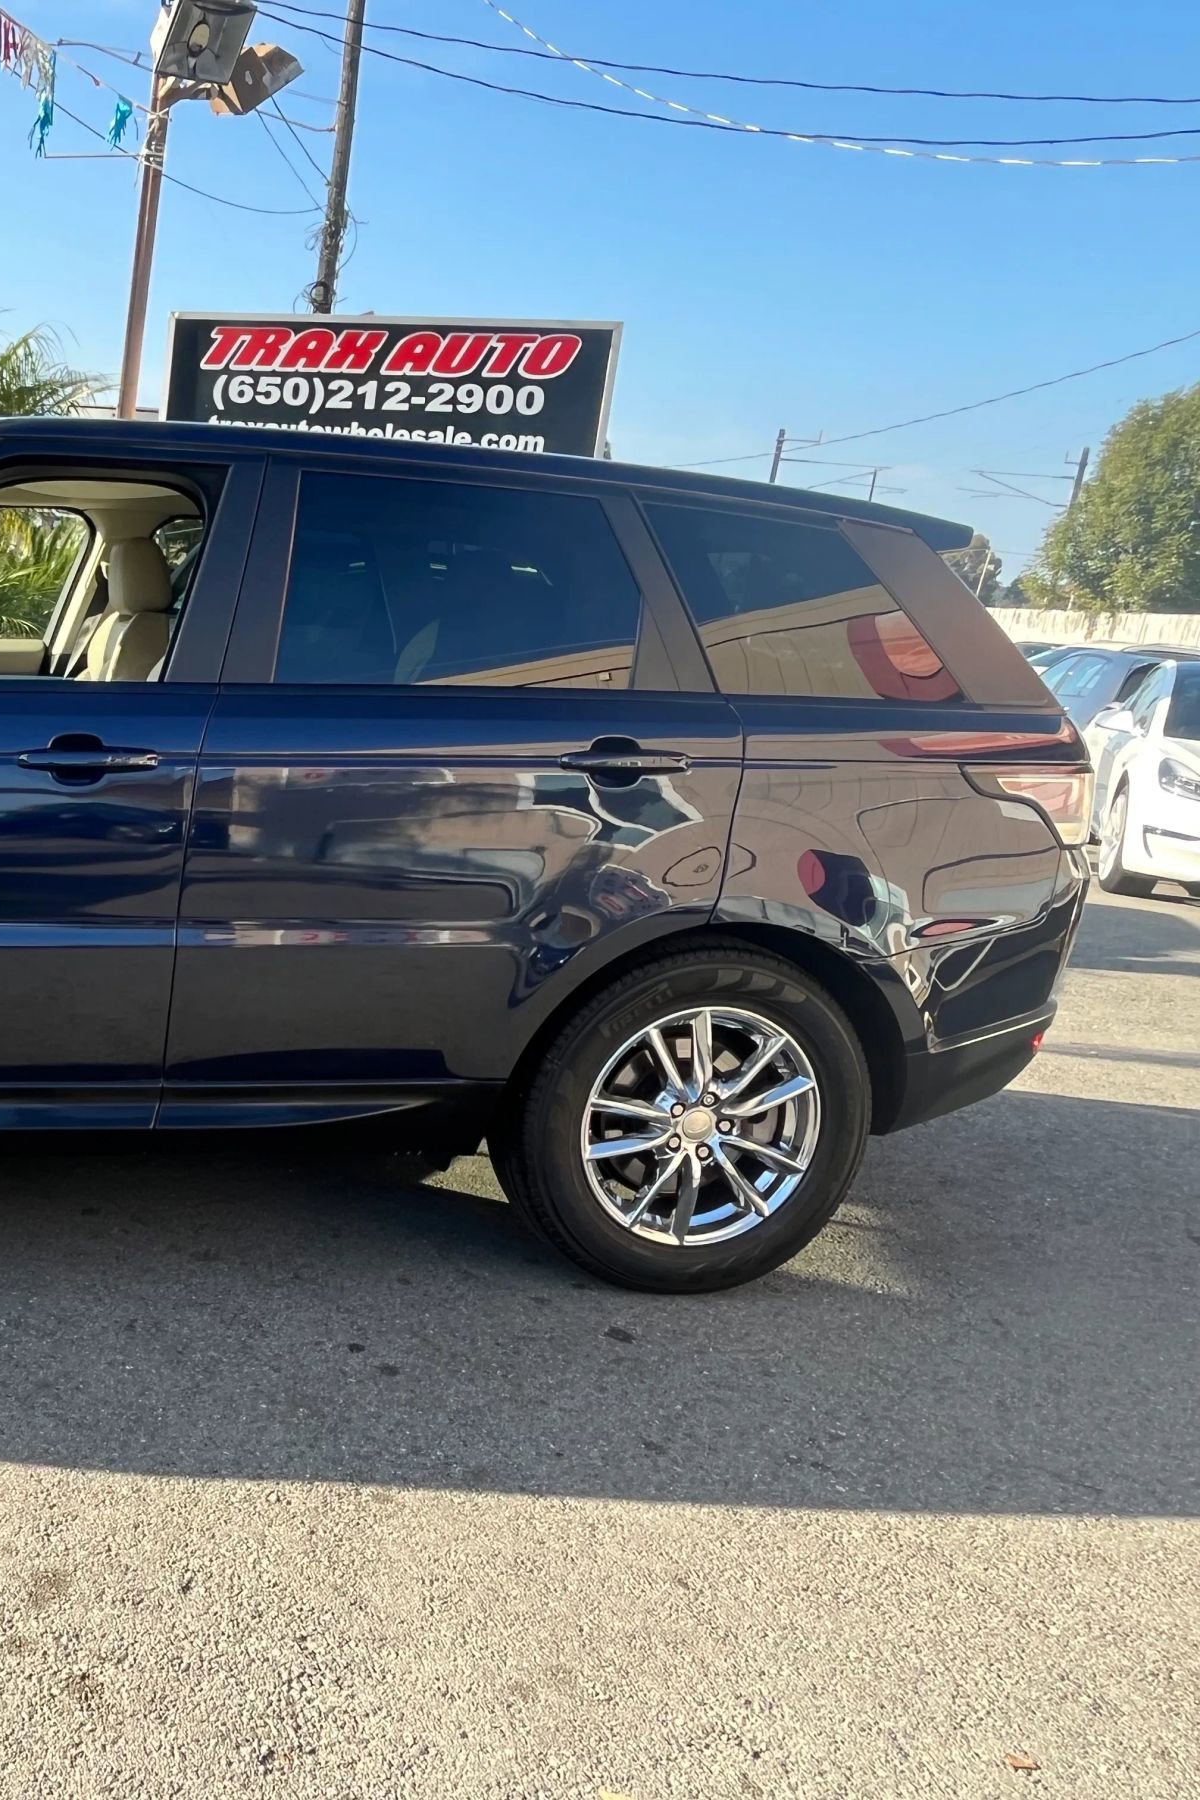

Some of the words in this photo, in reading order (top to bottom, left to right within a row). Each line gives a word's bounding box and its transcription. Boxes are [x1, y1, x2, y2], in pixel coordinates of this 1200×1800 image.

[200, 326, 389, 374] TRAX
[380, 331, 582, 380] AUTO
[212, 374, 545, 416] (650)212-2900
